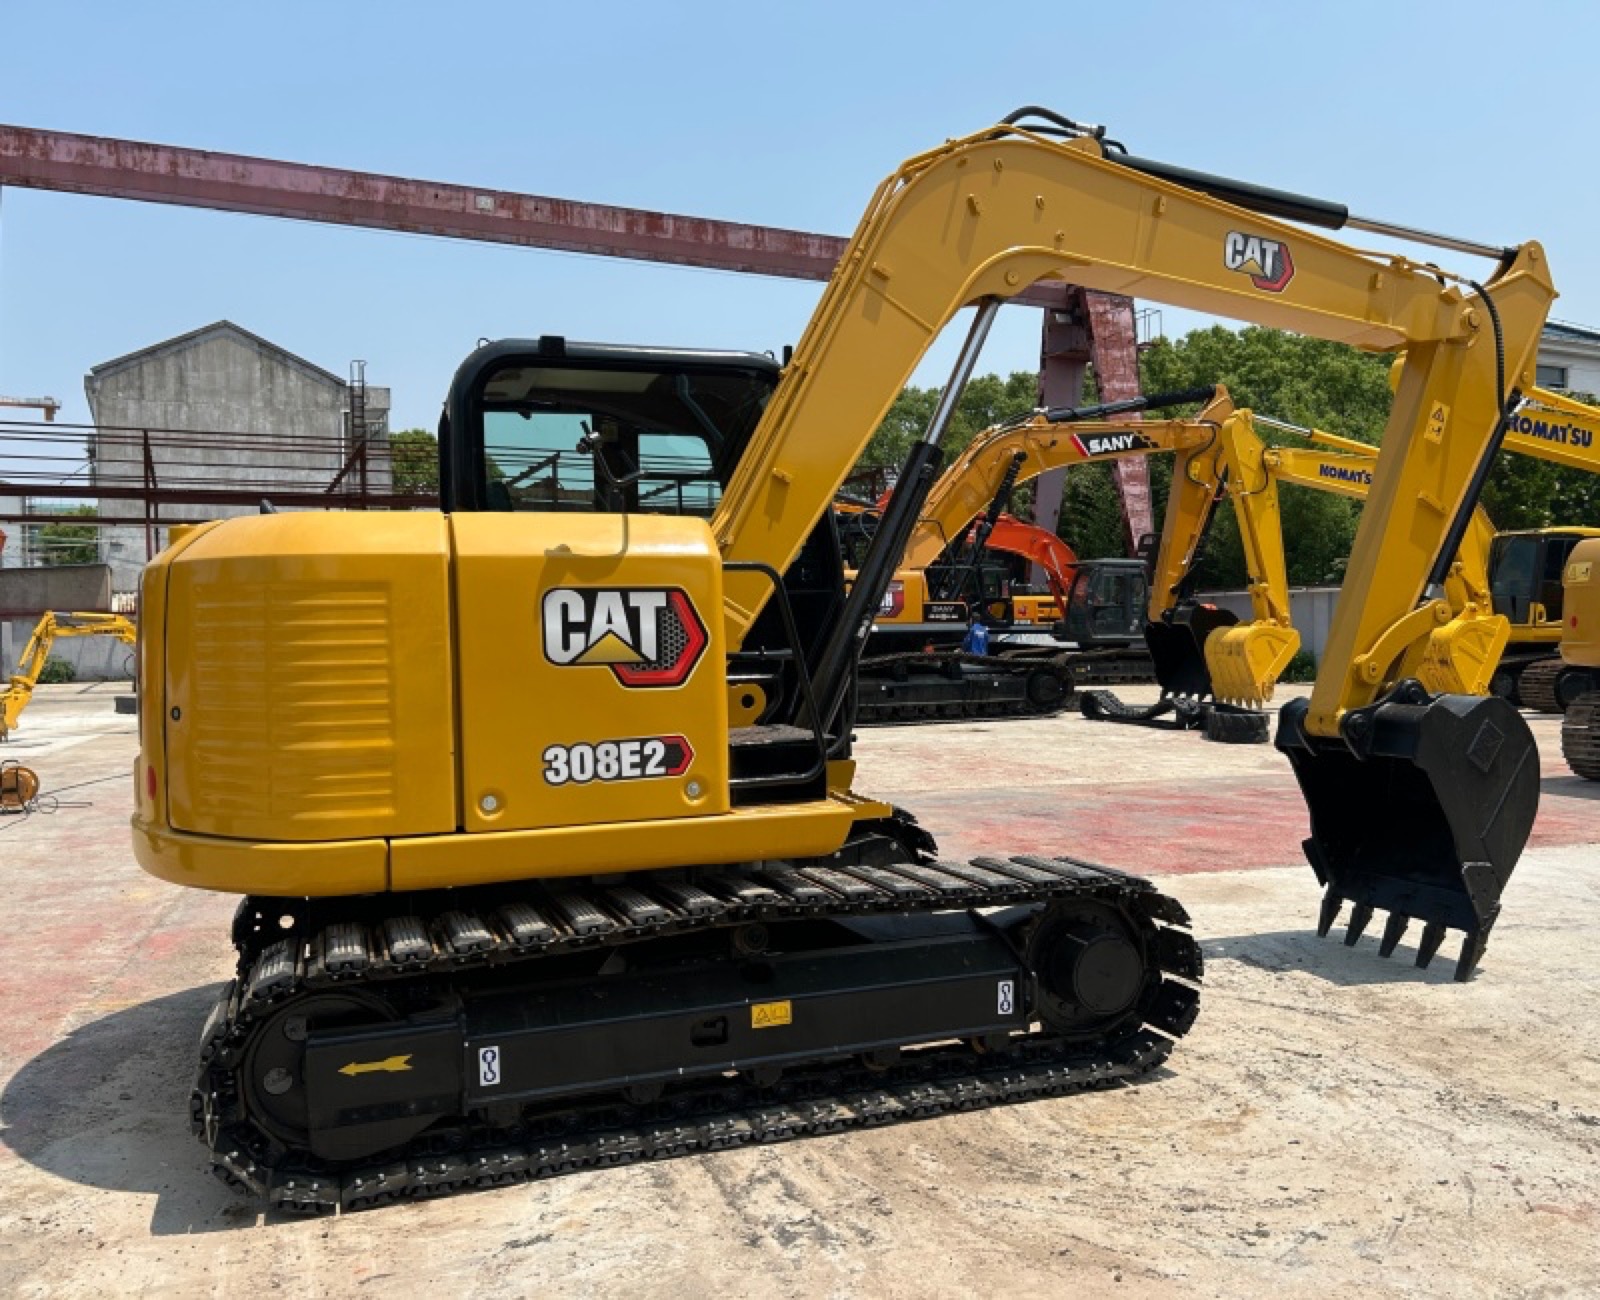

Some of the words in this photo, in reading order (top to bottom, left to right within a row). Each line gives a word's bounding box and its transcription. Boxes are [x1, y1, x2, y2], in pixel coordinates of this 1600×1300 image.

[1226, 231, 1279, 279] CAT
[1089, 435, 1134, 453] SANY
[543, 589, 668, 663] CAT
[543, 740, 667, 783] 308E2
